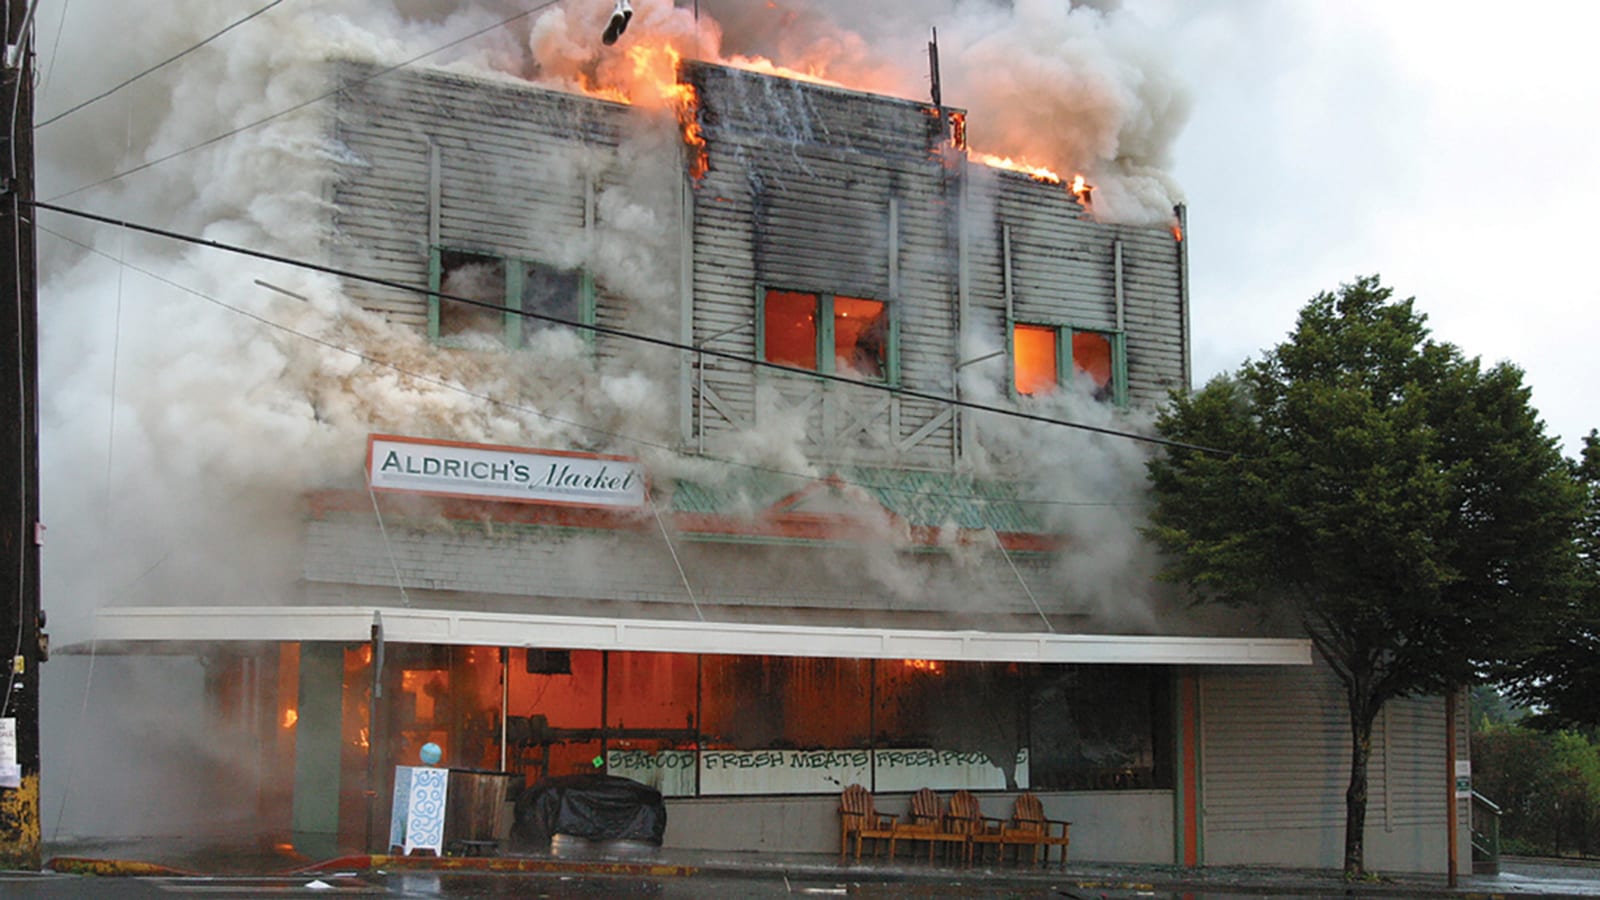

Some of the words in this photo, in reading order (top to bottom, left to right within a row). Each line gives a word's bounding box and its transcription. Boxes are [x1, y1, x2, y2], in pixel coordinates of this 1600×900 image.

[381, 450, 530, 482] ALDRICH'S
[529, 463, 635, 490] Market
[703, 752, 783, 769] FRESH
[790, 751, 869, 769] MEATS
[876, 751, 940, 767] FRESH
